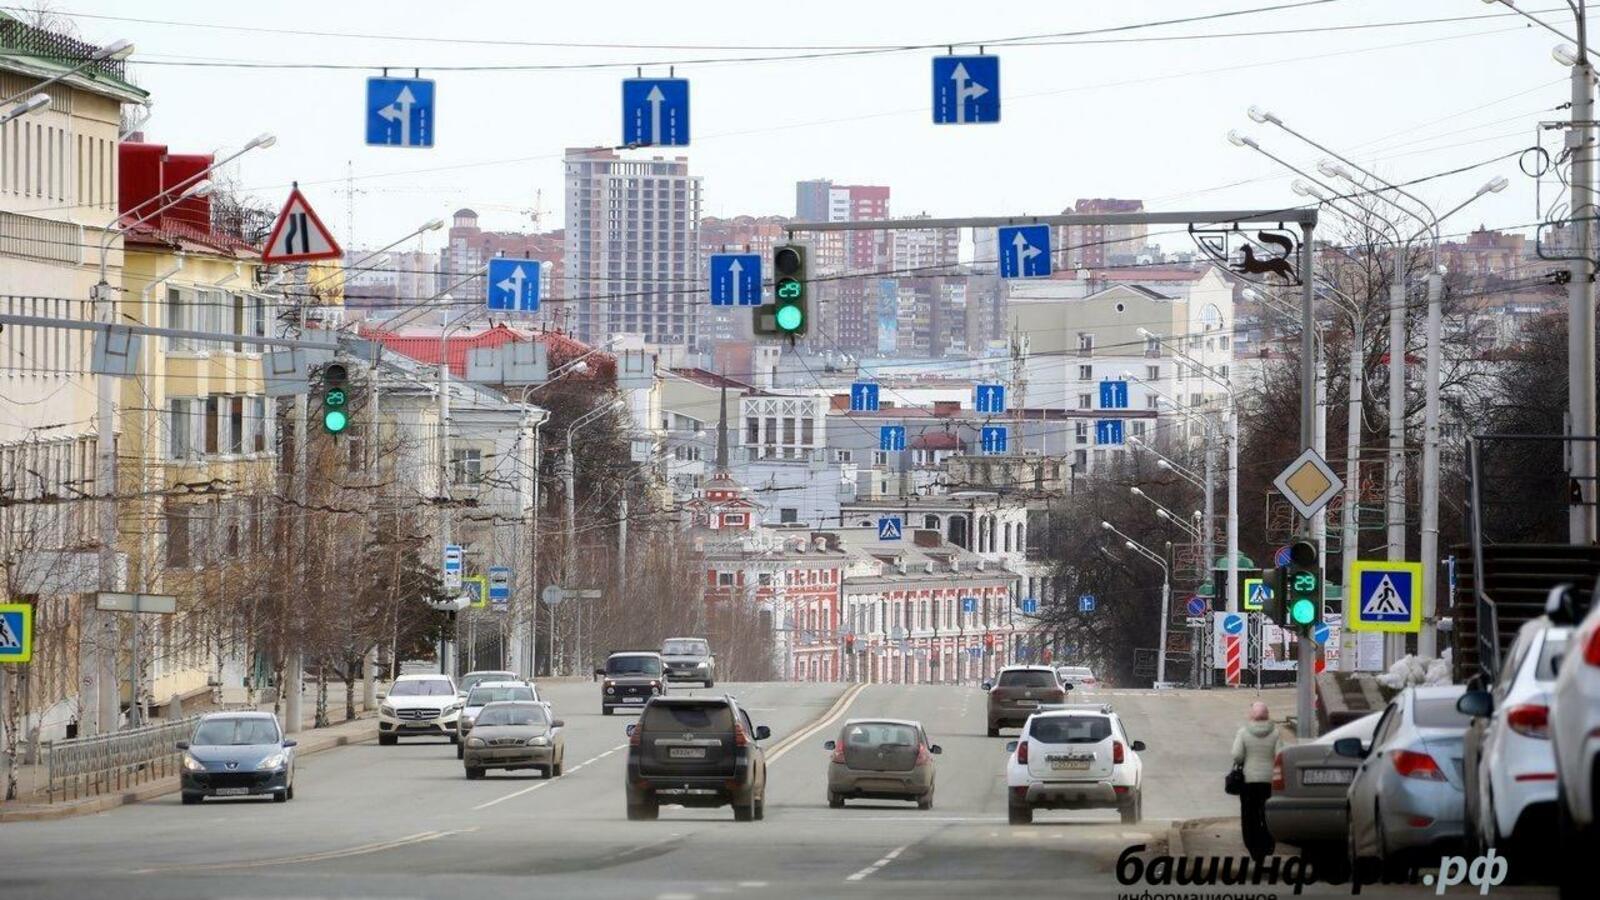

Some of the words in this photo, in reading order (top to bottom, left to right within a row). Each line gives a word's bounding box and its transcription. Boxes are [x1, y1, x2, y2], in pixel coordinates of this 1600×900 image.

[779, 282, 800, 298] 29
[326, 391, 344, 405] 29
[1294, 575, 1315, 591] 29
